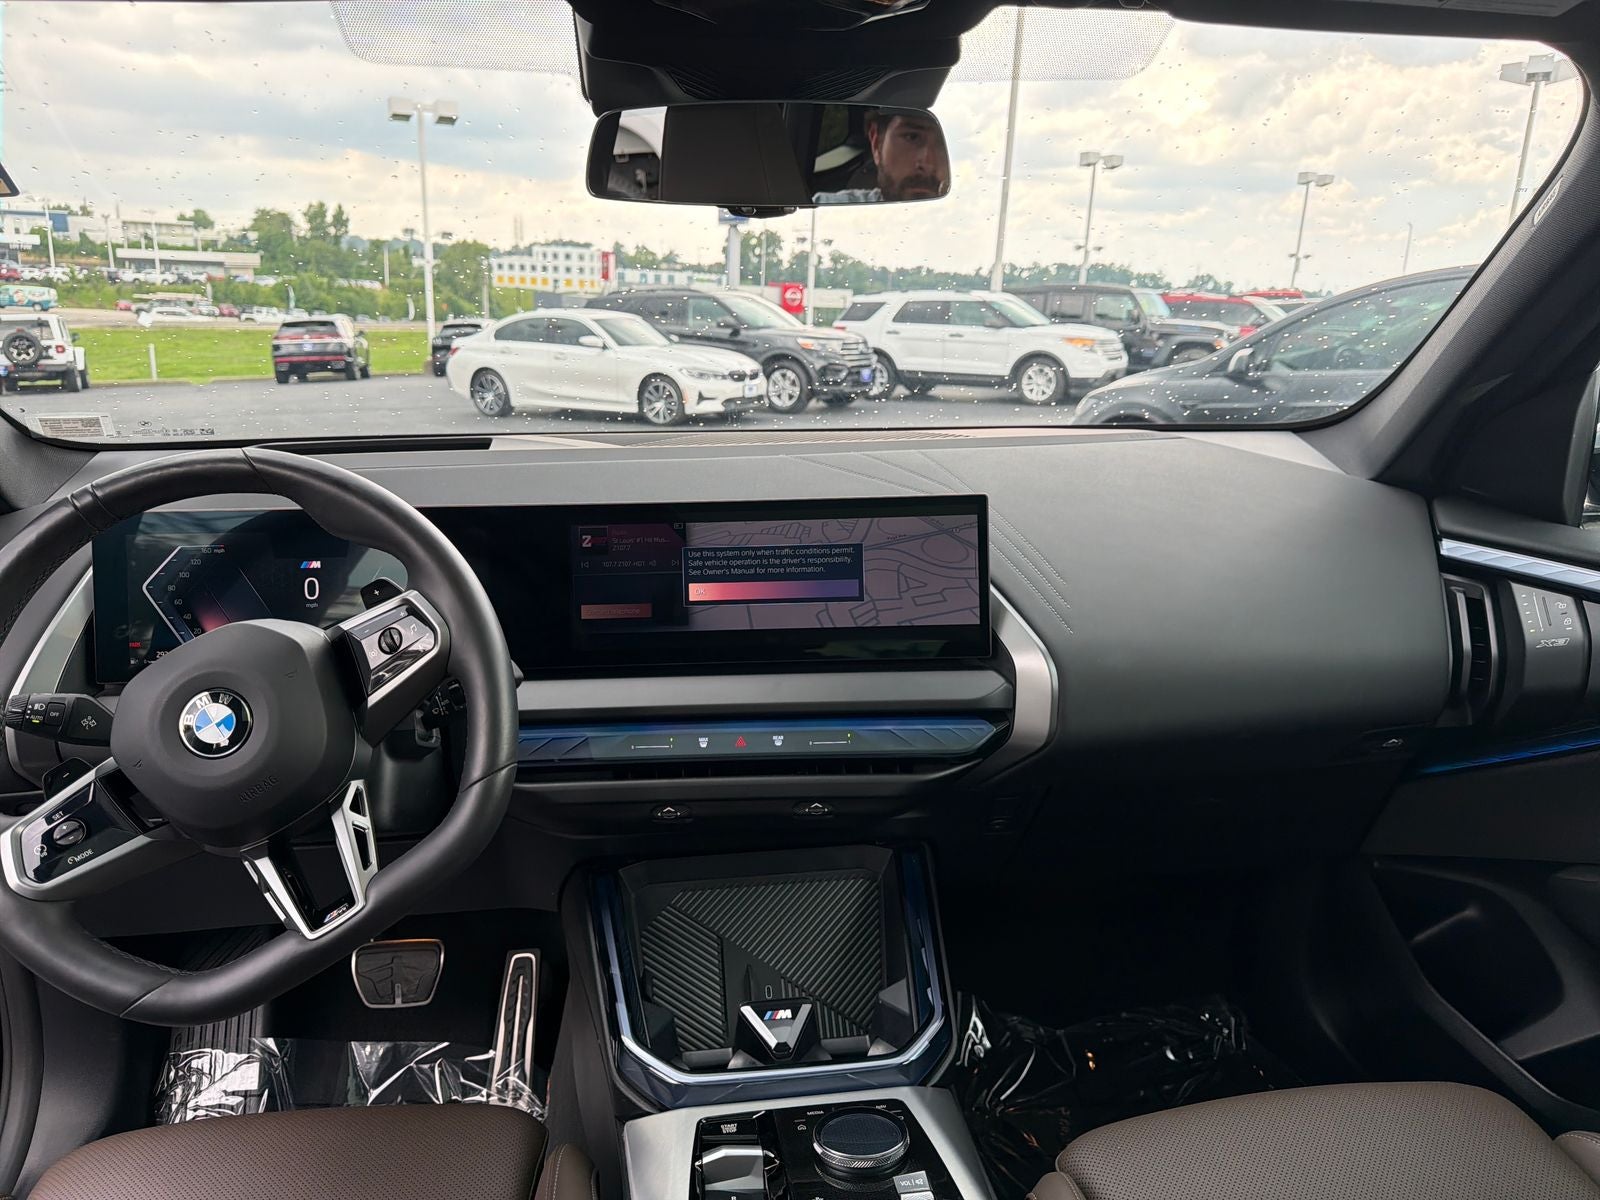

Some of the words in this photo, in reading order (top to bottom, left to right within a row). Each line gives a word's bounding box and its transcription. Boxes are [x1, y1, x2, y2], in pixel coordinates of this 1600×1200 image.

[688, 550, 701, 558] Use
[717, 549, 740, 558] system
[741, 549, 756, 558] only
[775, 548, 795, 556] traffic
[795, 547, 831, 555] conditions
[831, 546, 856, 555] permit.
[190, 558, 202, 566] 120
[688, 559, 704, 567] Safe
[728, 558, 761, 567] operation
[762, 557, 769, 565] is
[769, 557, 781, 565] the
[781, 556, 807, 565] driver's
[807, 556, 854, 565] responsibility.
[179, 571, 190, 579] 100
[688, 568, 701, 576] See
[702, 568, 730, 576] Owner's
[730, 567, 756, 575] Manual
[756, 566, 766, 574] for
[785, 565, 827, 574] information.
[167, 584, 176, 592] 80
[304, 577, 320, 600] 0
[174, 598, 183, 606] 60
[183, 613, 192, 621] 40
[51, 810, 65, 821] SET
[75, 848, 94, 863] MODE
